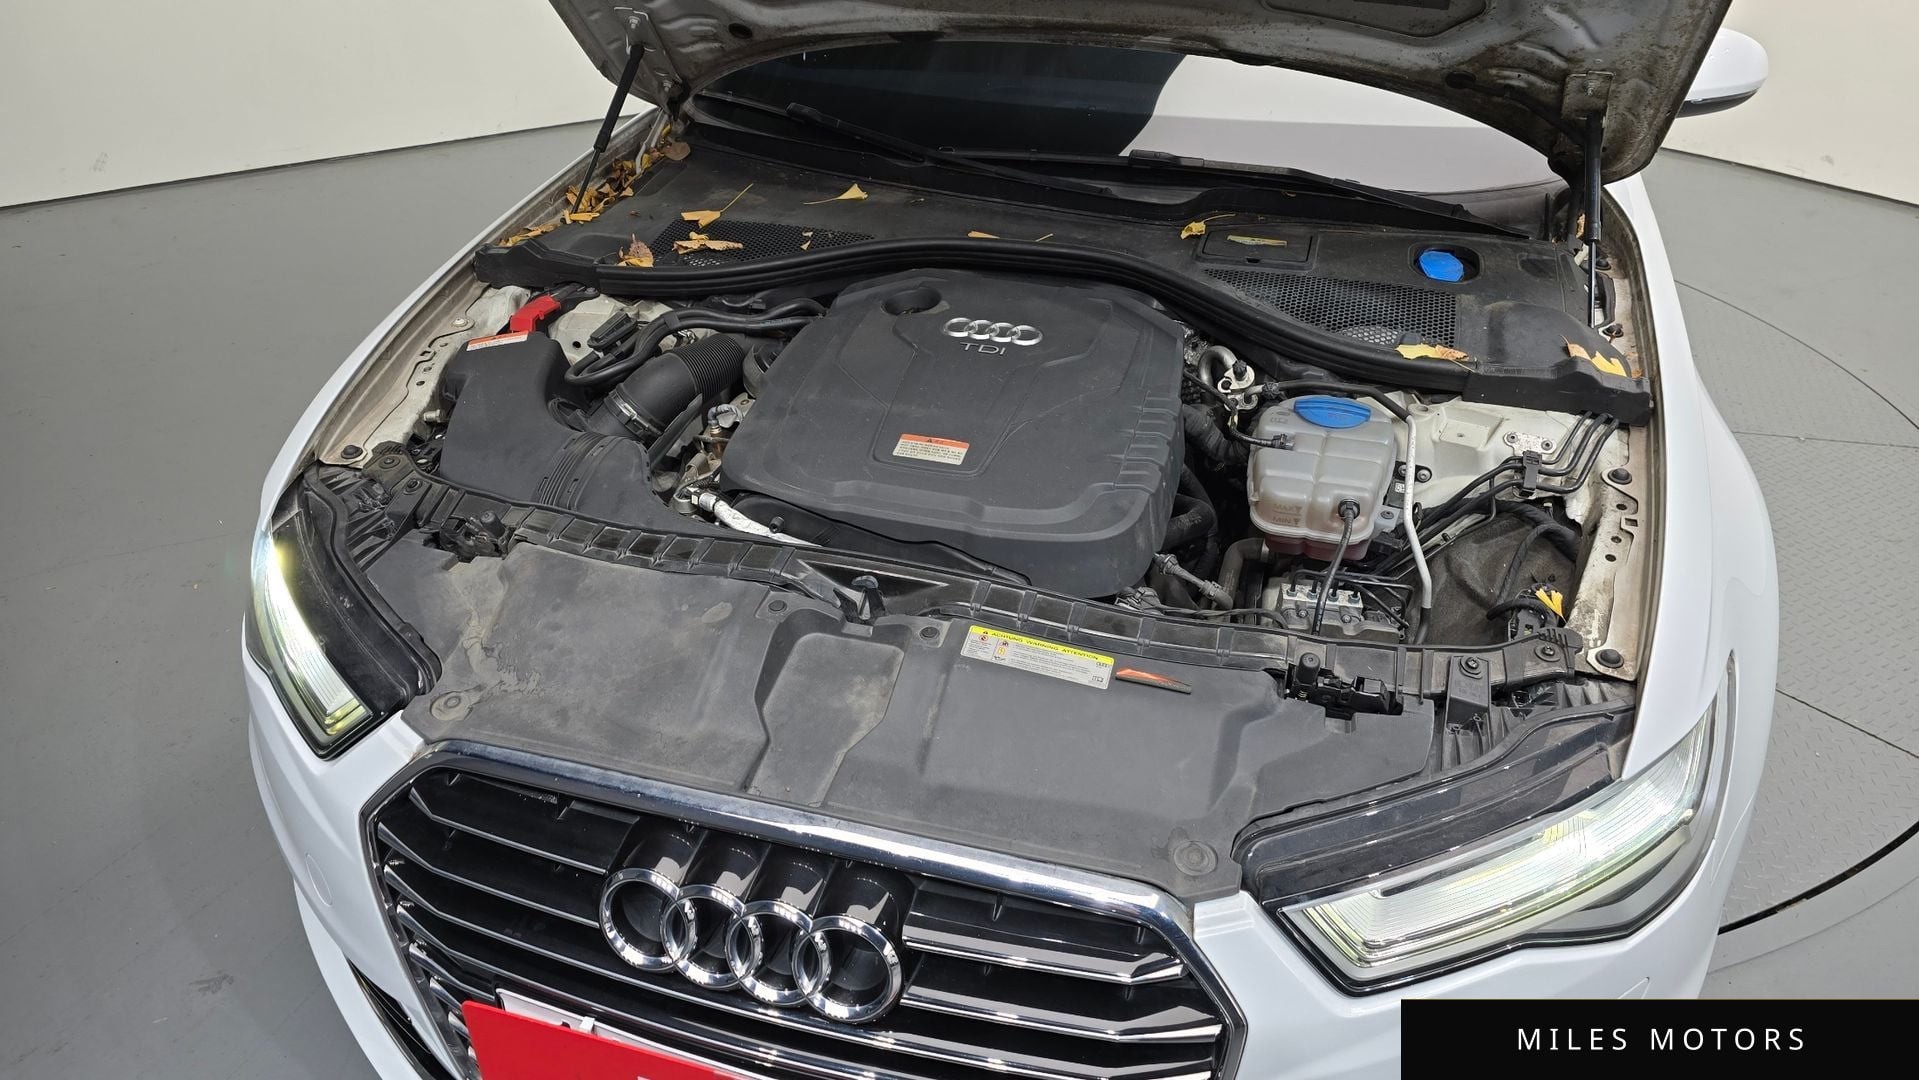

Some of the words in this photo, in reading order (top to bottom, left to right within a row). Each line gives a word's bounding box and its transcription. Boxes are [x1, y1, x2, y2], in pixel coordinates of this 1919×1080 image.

[960, 342, 1006, 355] TDI
[991, 632, 1023, 643] ACHTUNG
[1026, 640, 1059, 651] WARNING
[1061, 648, 1099, 661] ATTENTION
